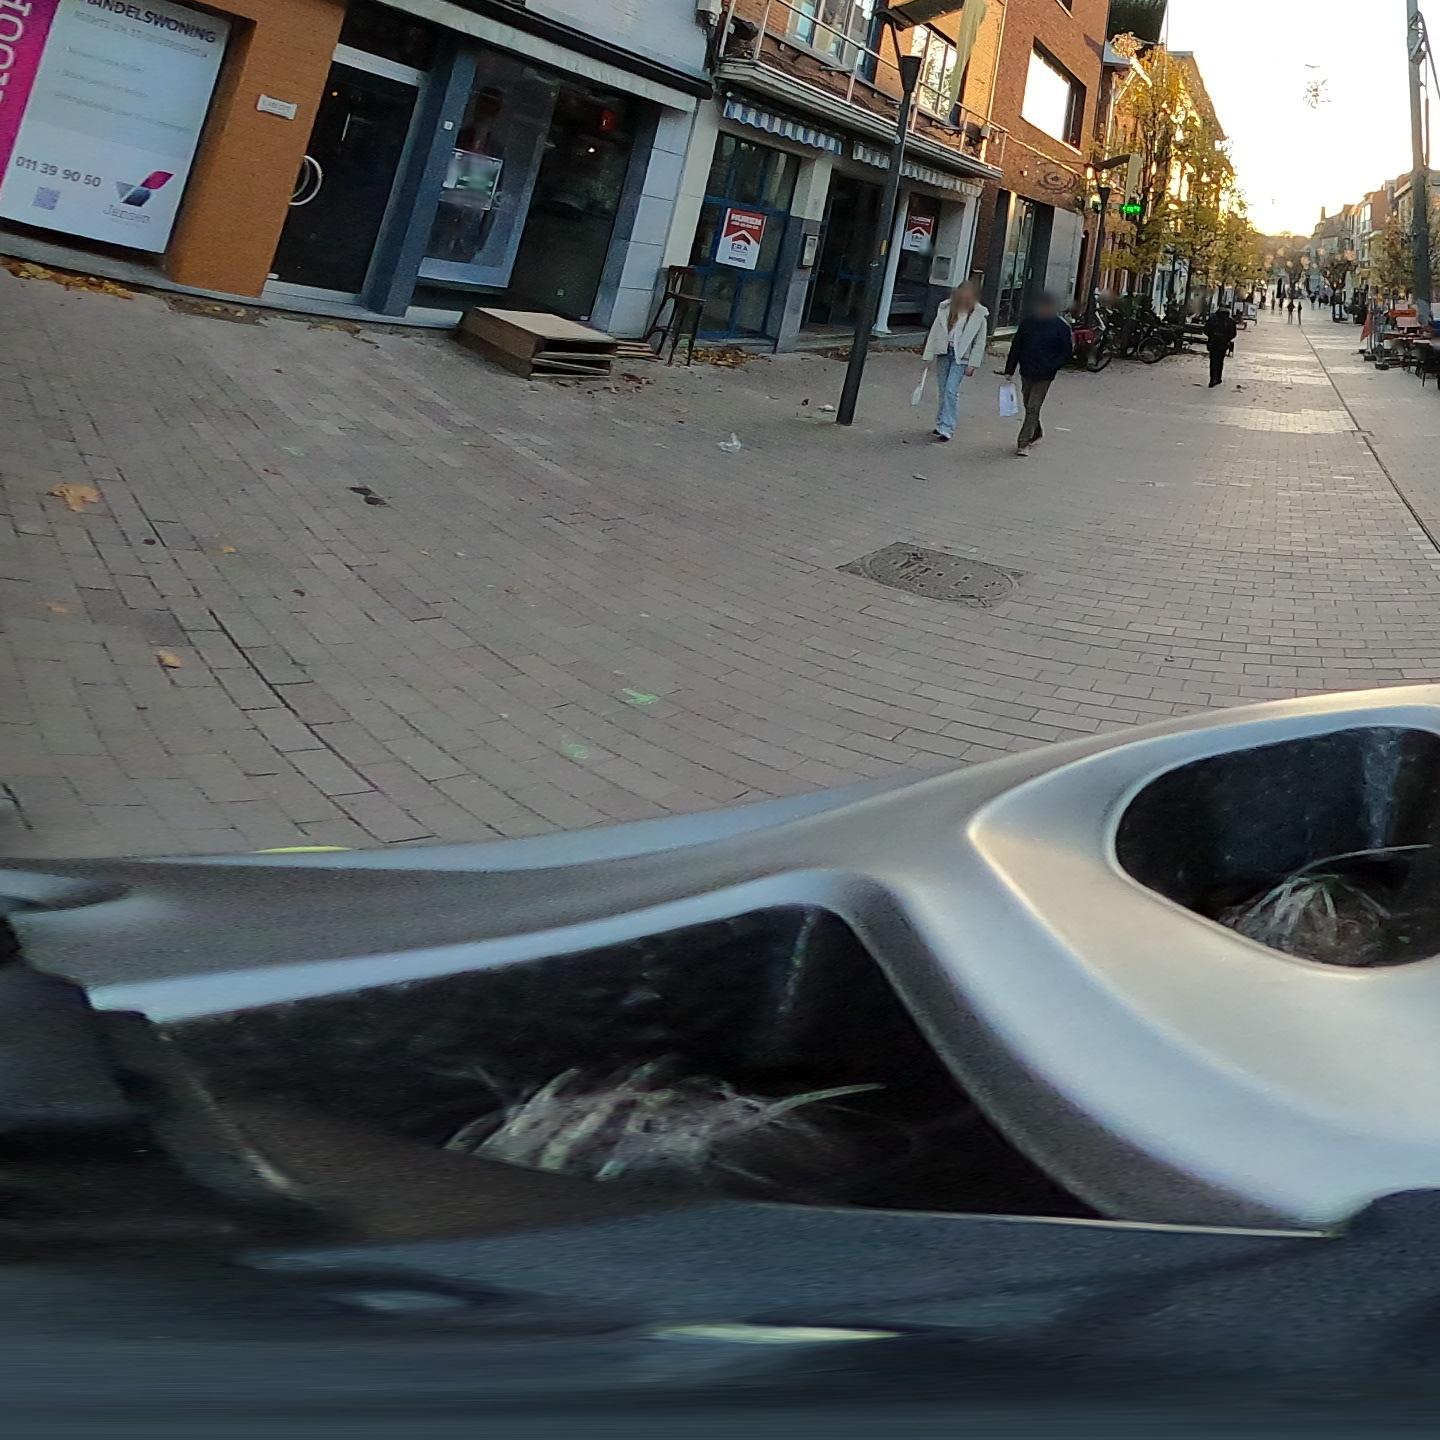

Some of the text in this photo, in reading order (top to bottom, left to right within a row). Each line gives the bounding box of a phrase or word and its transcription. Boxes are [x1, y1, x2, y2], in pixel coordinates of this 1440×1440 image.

[15, 156, 102, 187] 011 39 90 50
